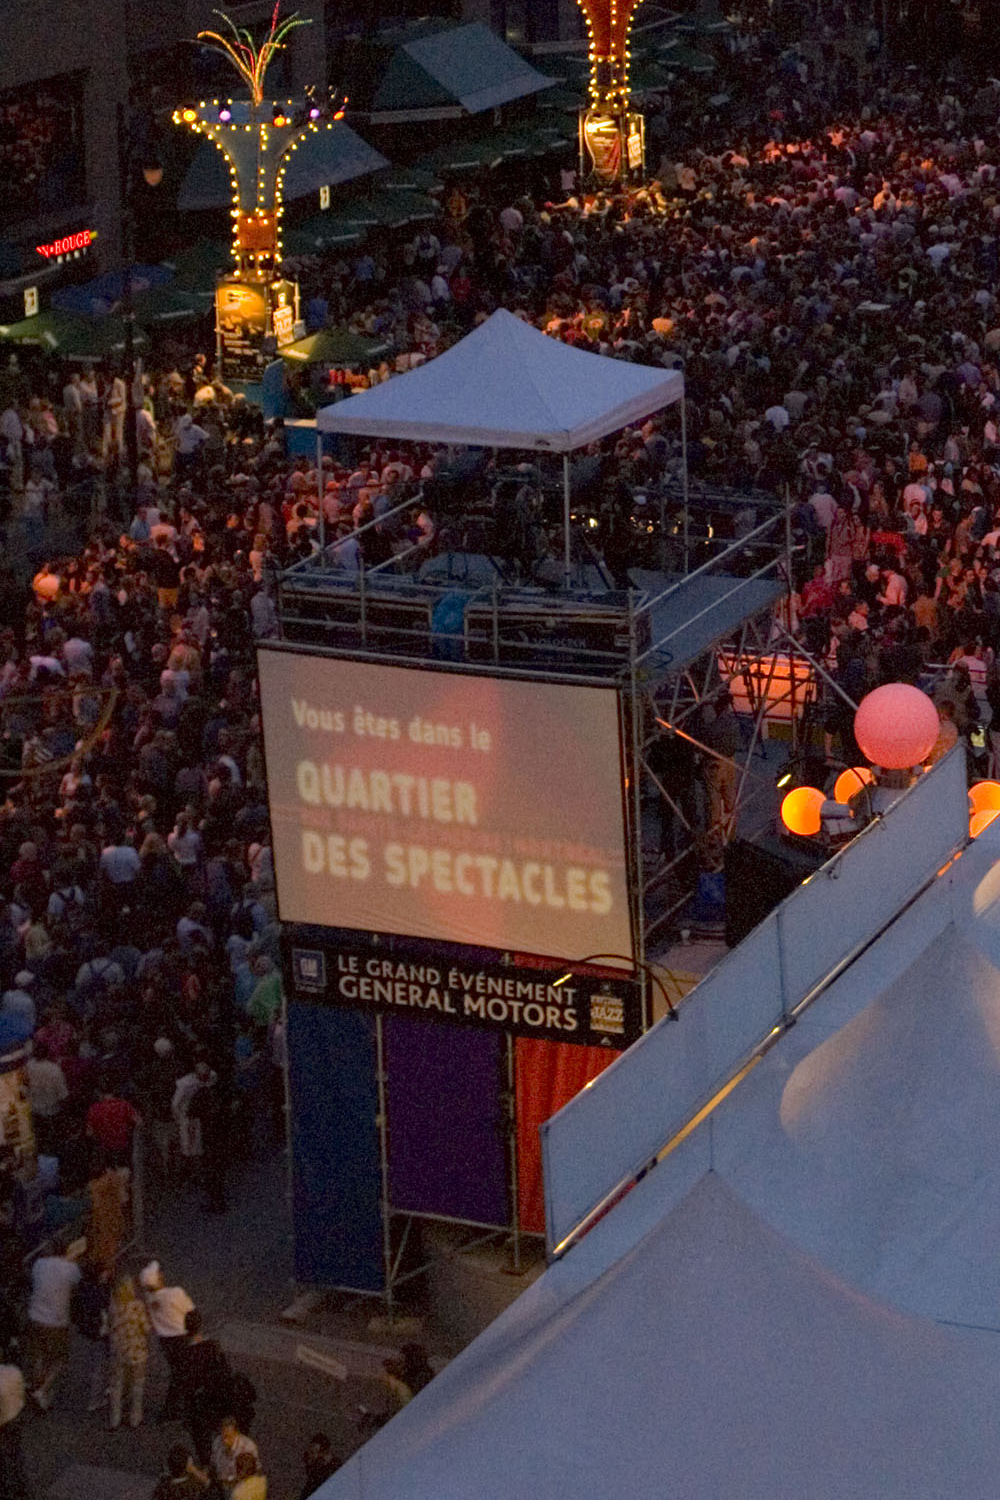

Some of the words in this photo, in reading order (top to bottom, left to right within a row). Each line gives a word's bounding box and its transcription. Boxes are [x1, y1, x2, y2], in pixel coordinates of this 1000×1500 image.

[54, 230, 91, 256] ROUGE
[292, 697, 345, 733] Vous
[353, 705, 400, 740] êtes
[408, 716, 462, 748] dans
[470, 724, 492, 752] le
[297, 761, 478, 825] QUARTIER
[302, 830, 371, 880] DES
[384, 843, 613, 916] SPECTACLES
[338, 954, 359, 974] LE
[366, 959, 440, 986] GRAND
[449, 968, 576, 1005] ÉVÉNEMENT
[338, 975, 452, 1014] GENERAL
[464, 994, 578, 1031] MOTORS
[591, 1005, 624, 1022] JAZZ
